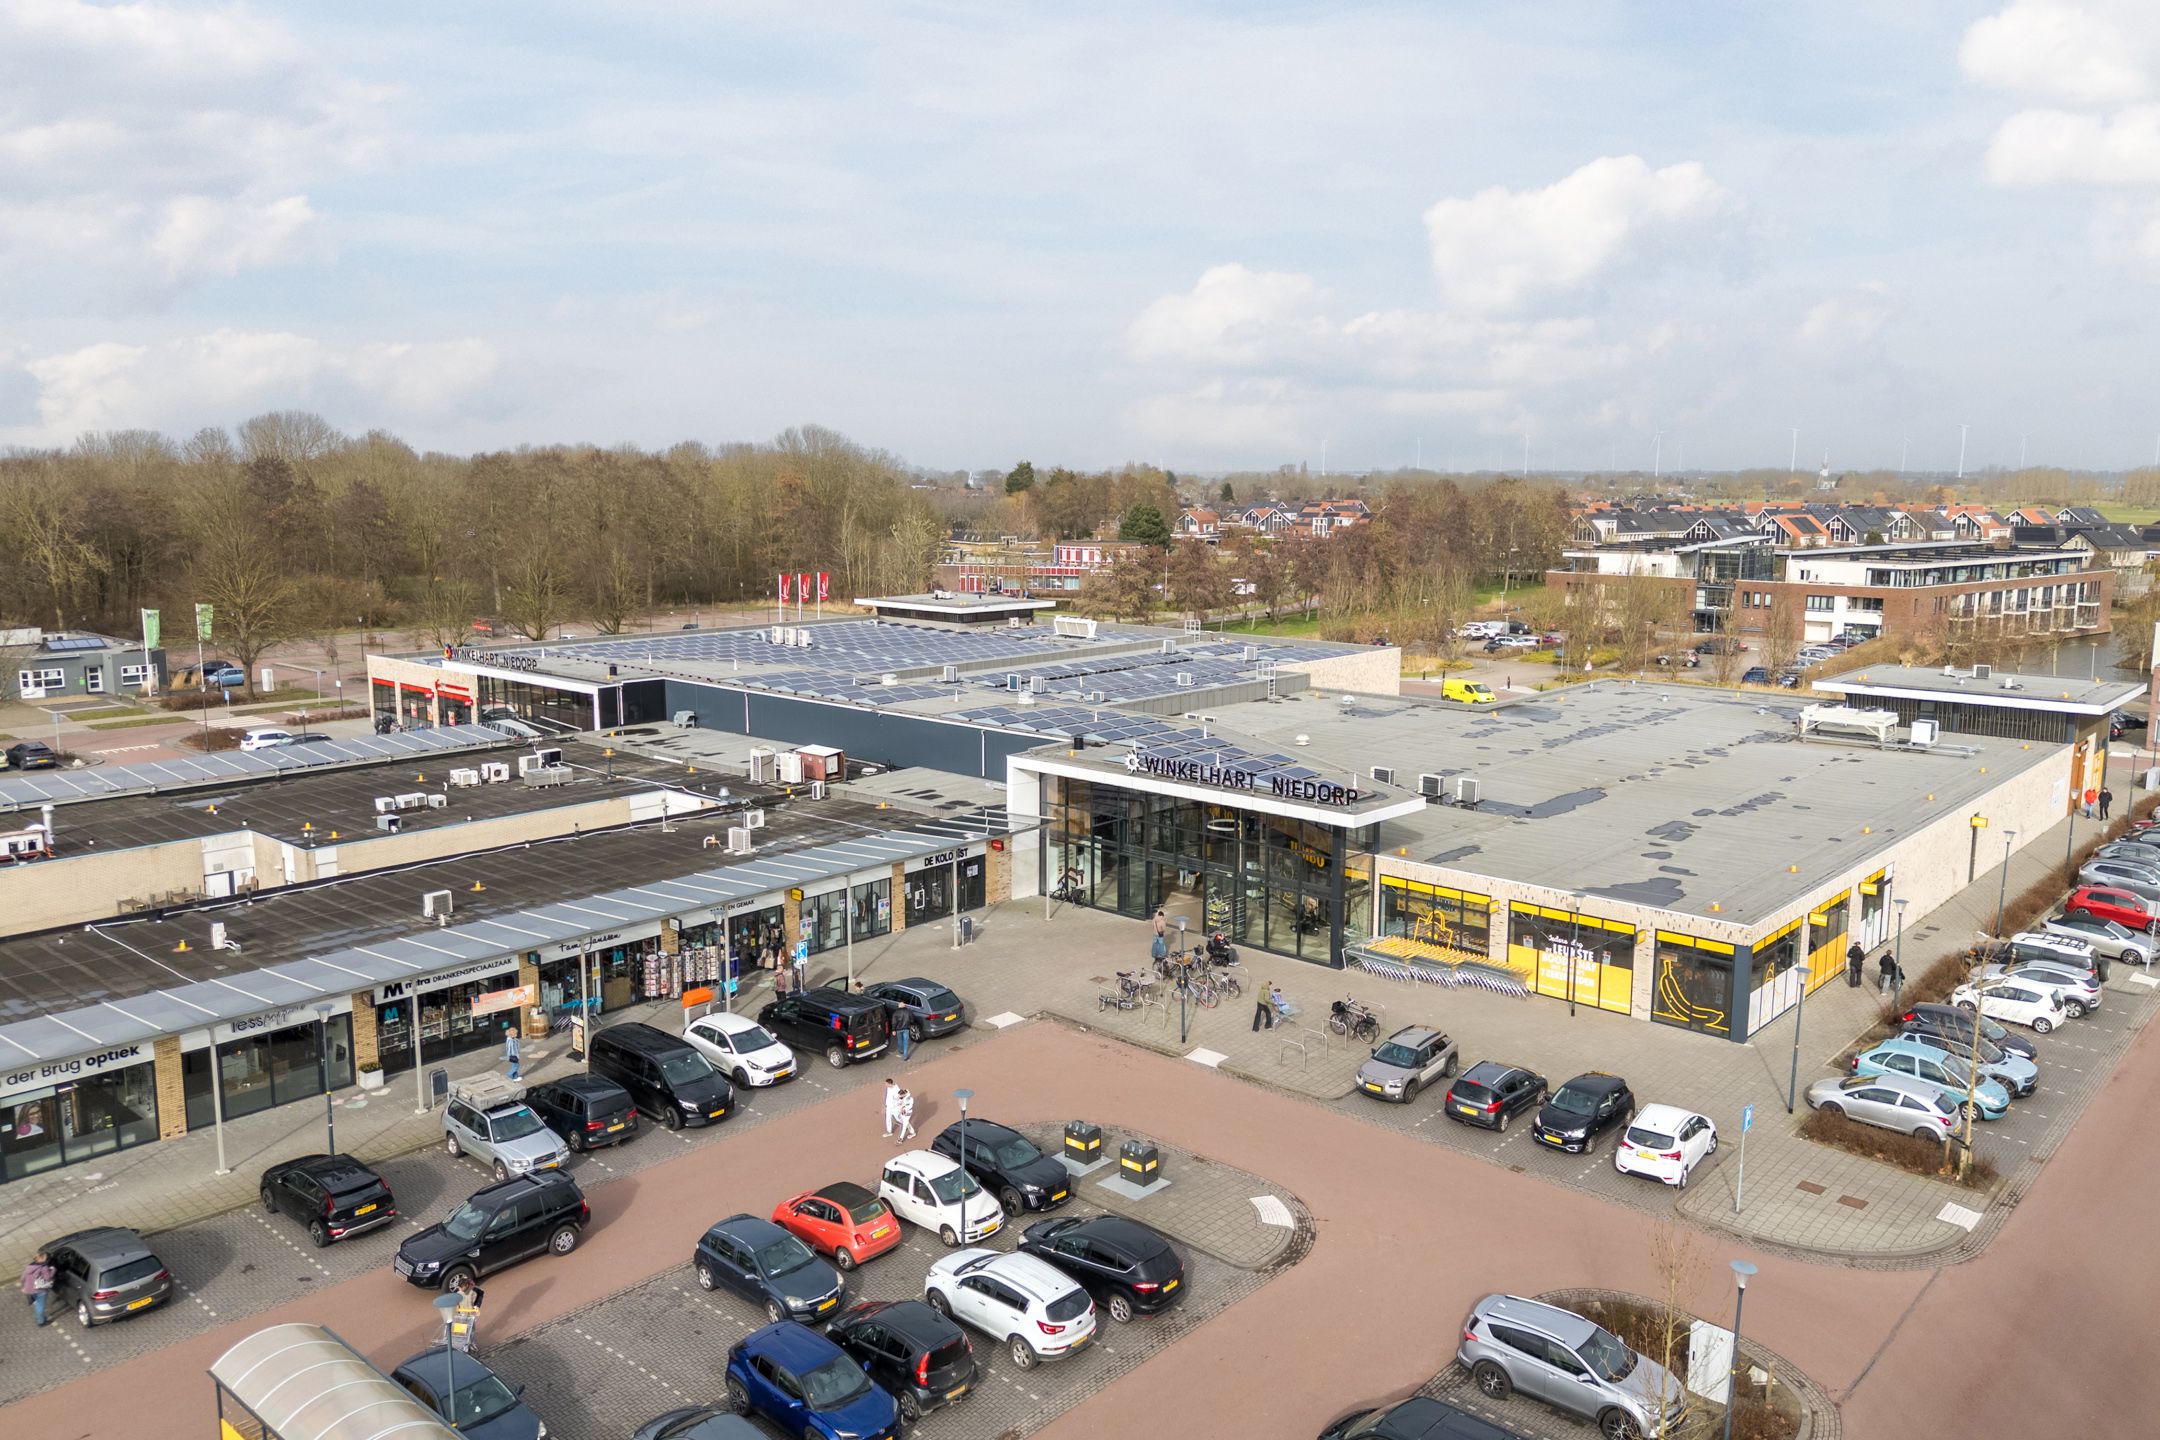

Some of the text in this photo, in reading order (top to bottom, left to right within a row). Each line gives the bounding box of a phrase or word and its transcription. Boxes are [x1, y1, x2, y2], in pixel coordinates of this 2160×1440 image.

[452, 647, 538, 671] WINKELHART NIEDORP
[1144, 756, 1358, 806] WINKELHART NIEDORP
[924, 857, 934, 866] DE
[736, 900, 755, 909] GEMAK
[432, 958, 512, 983] DRANKENSPECIAALZAAK
[6, 1071, 37, 1085] der
[41, 1060, 80, 1078] Brug
